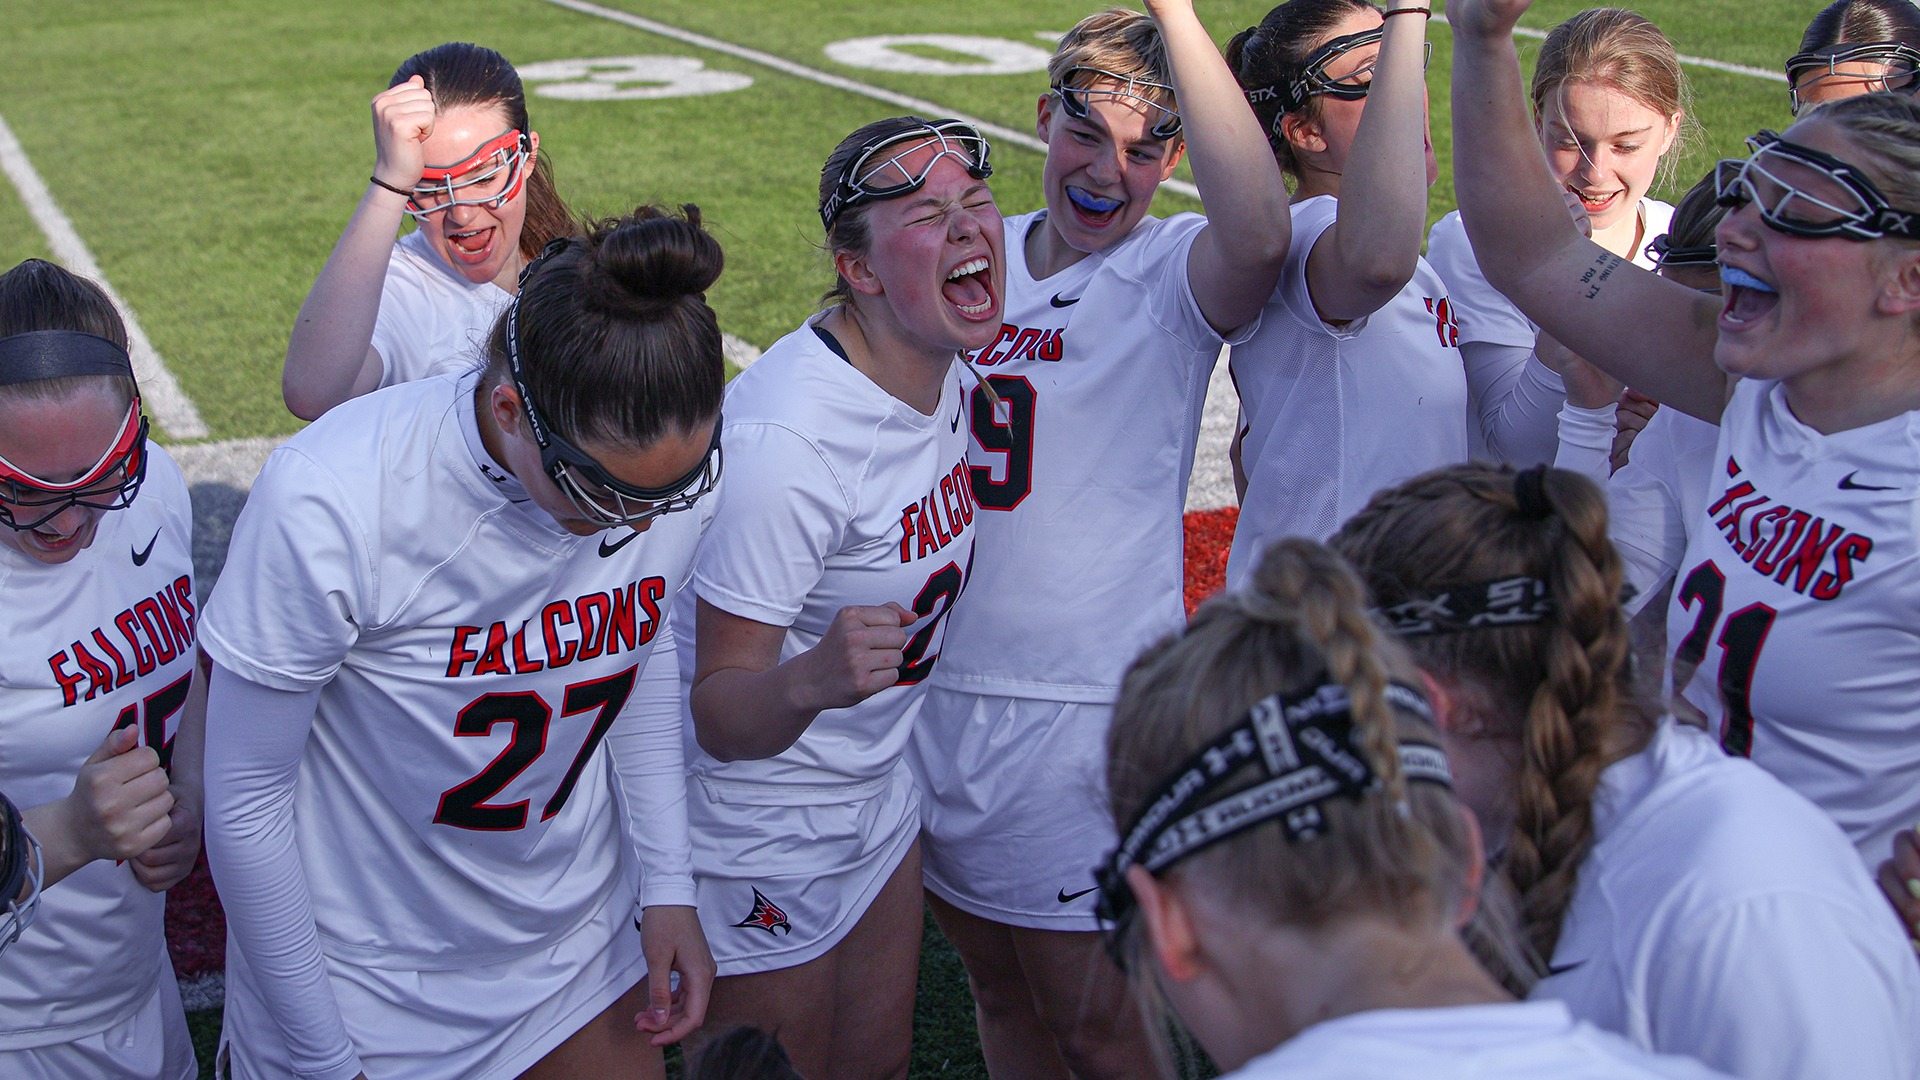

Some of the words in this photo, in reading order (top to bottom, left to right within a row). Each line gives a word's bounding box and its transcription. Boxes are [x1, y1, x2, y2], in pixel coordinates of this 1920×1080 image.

[1250, 86, 1278, 103] STX
[823, 188, 843, 222] STX
[517, 380, 548, 447] ARMO
[967, 373, 1038, 512] 9
[47, 574, 196, 707] FALCONS
[445, 575, 666, 678] FALCONS
[1672, 559, 1777, 758] 21
[432, 662, 640, 832] 27
